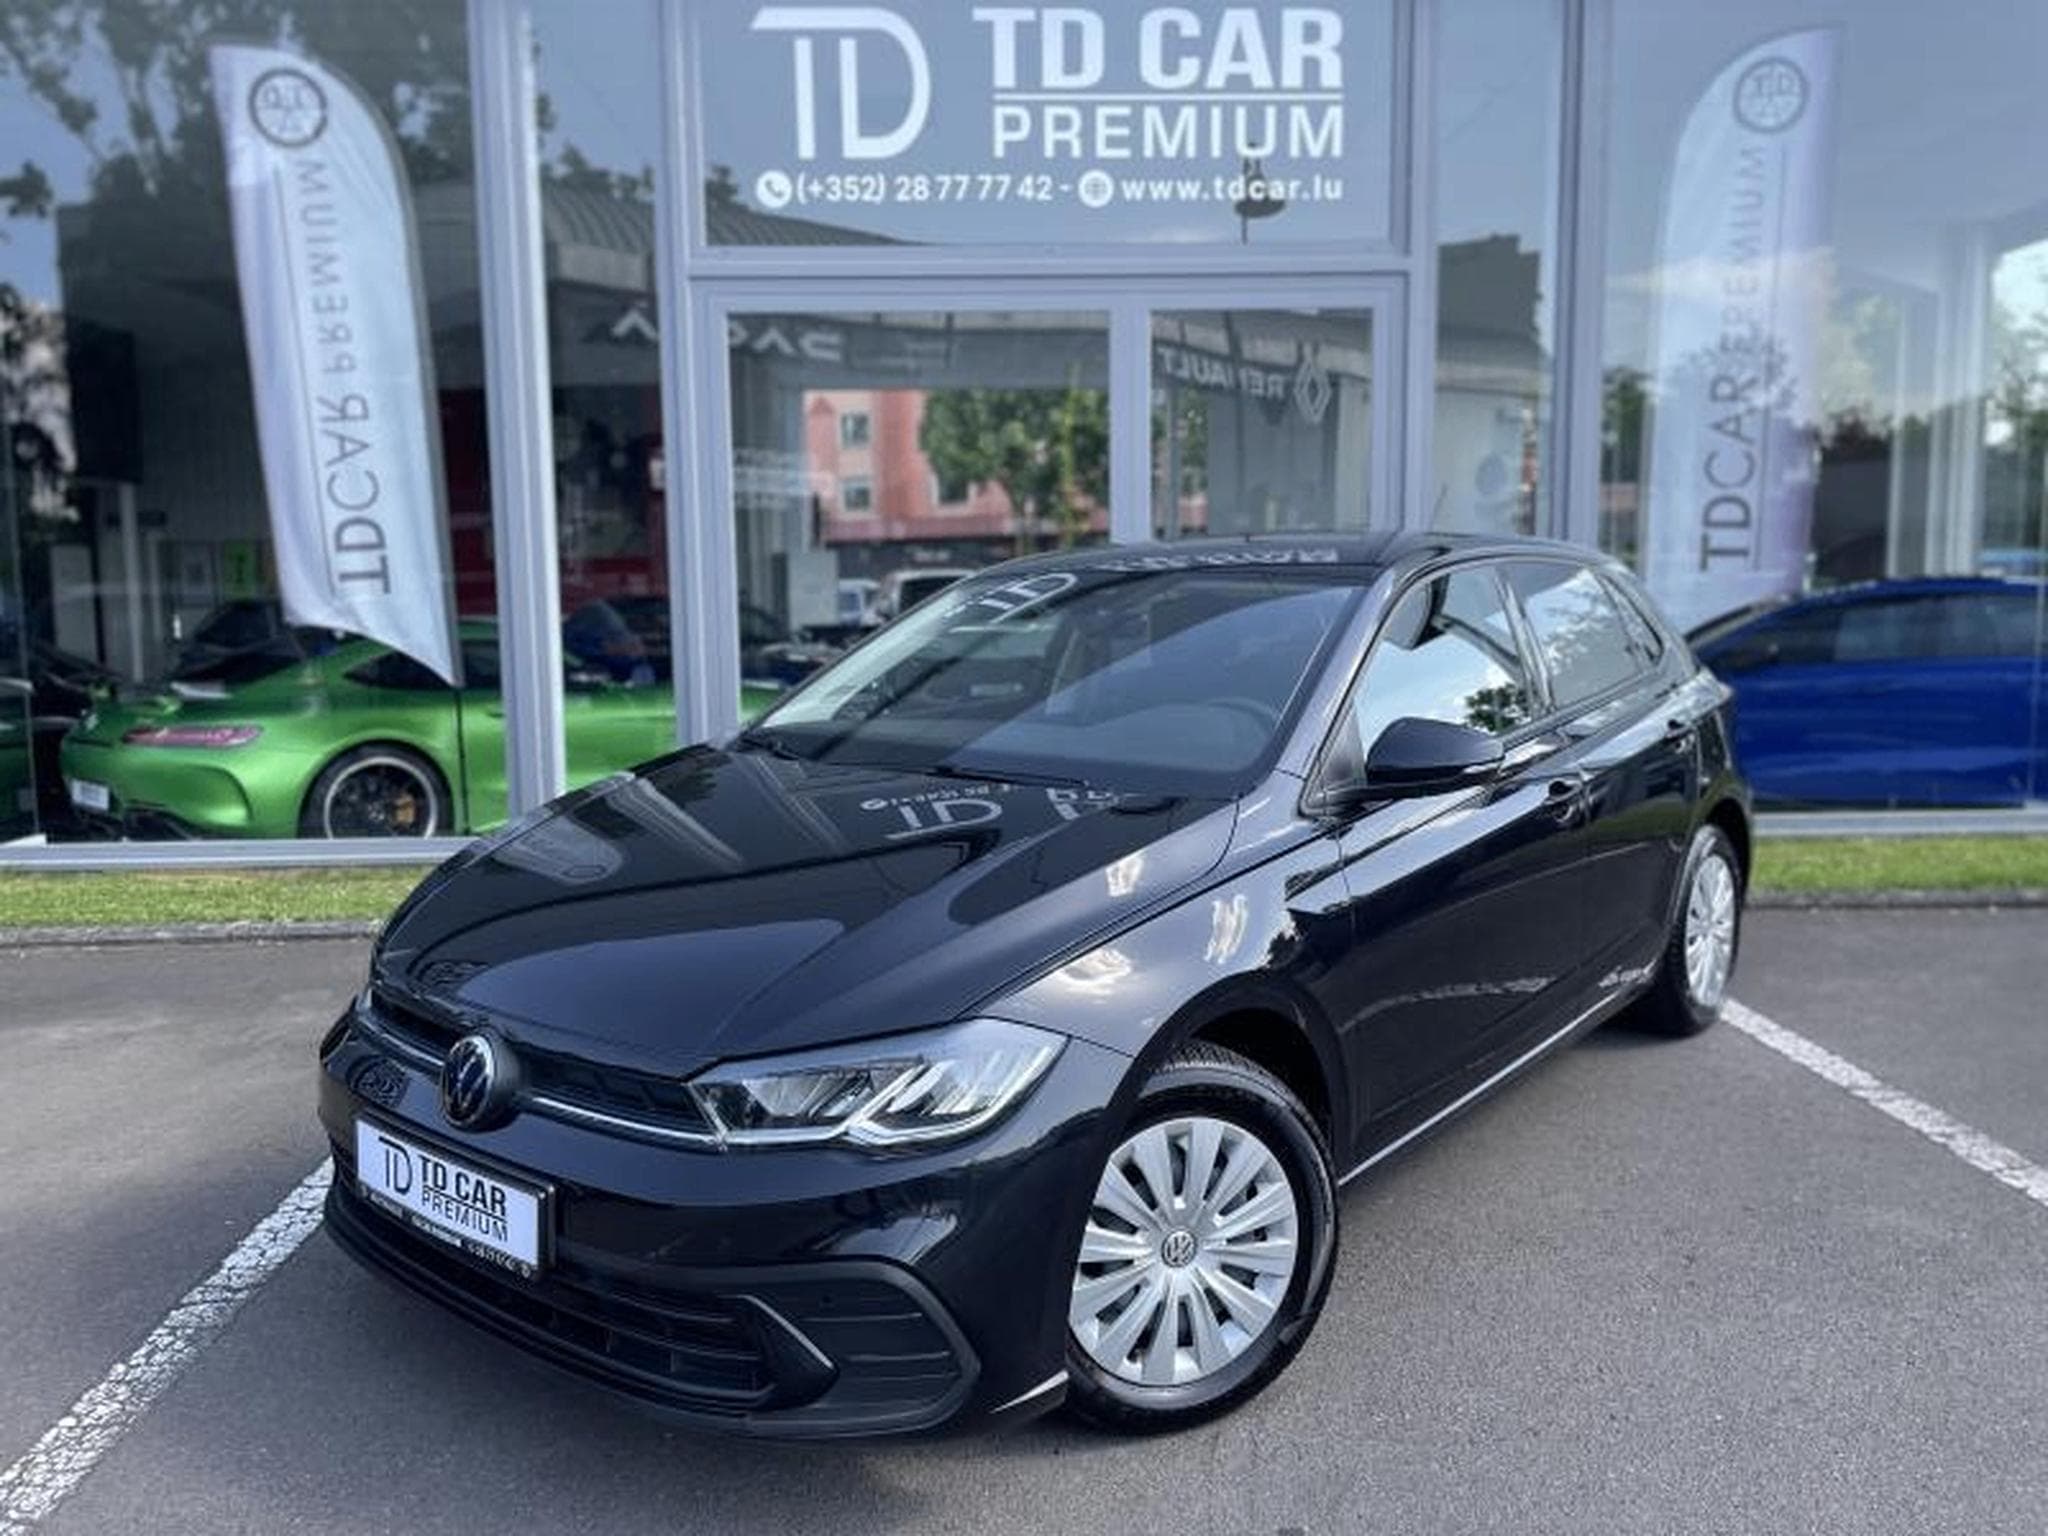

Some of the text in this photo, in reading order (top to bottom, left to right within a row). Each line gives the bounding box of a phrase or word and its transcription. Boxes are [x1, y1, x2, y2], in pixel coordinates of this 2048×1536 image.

[973, 8, 1343, 90] TD CAR
[993, 105, 1343, 158] PREMIUM
[797, 172, 886, 204] (+352)
[895, 174, 931, 201] 28
[935, 174, 970, 201] 77
[976, 174, 1012, 201] 77
[1017, 174, 1054, 201] 42
[1121, 174, 1343, 201] www.tdcar.lu
[418, 1154, 507, 1217] TD CAR
[422, 1189, 509, 1243] PREMIUM
